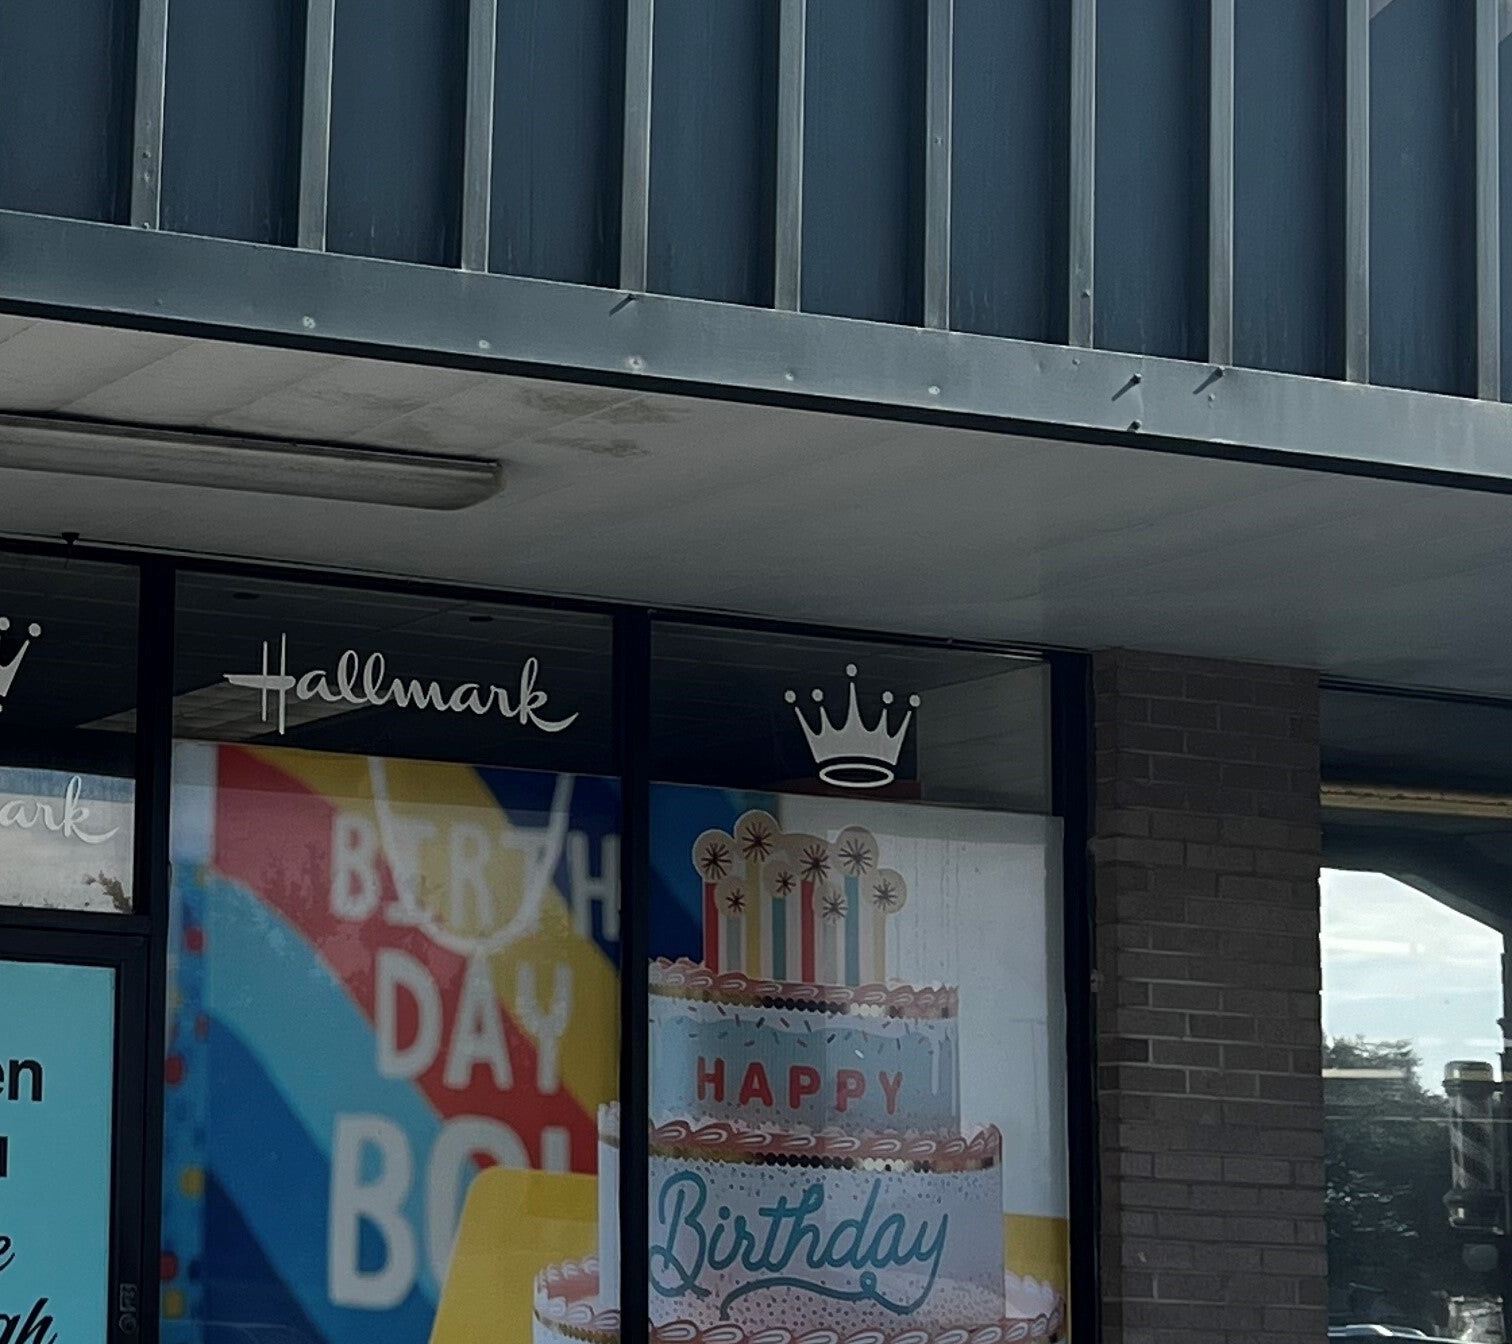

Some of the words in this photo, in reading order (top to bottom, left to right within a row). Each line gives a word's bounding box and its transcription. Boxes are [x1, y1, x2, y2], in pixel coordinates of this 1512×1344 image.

[223, 632, 579, 735] Hallmark
[330, 813, 622, 942] BIRTH
[375, 946, 573, 1094] DAY
[696, 1055, 903, 1116] HAPPY
[650, 1170, 949, 1320] Birthday
